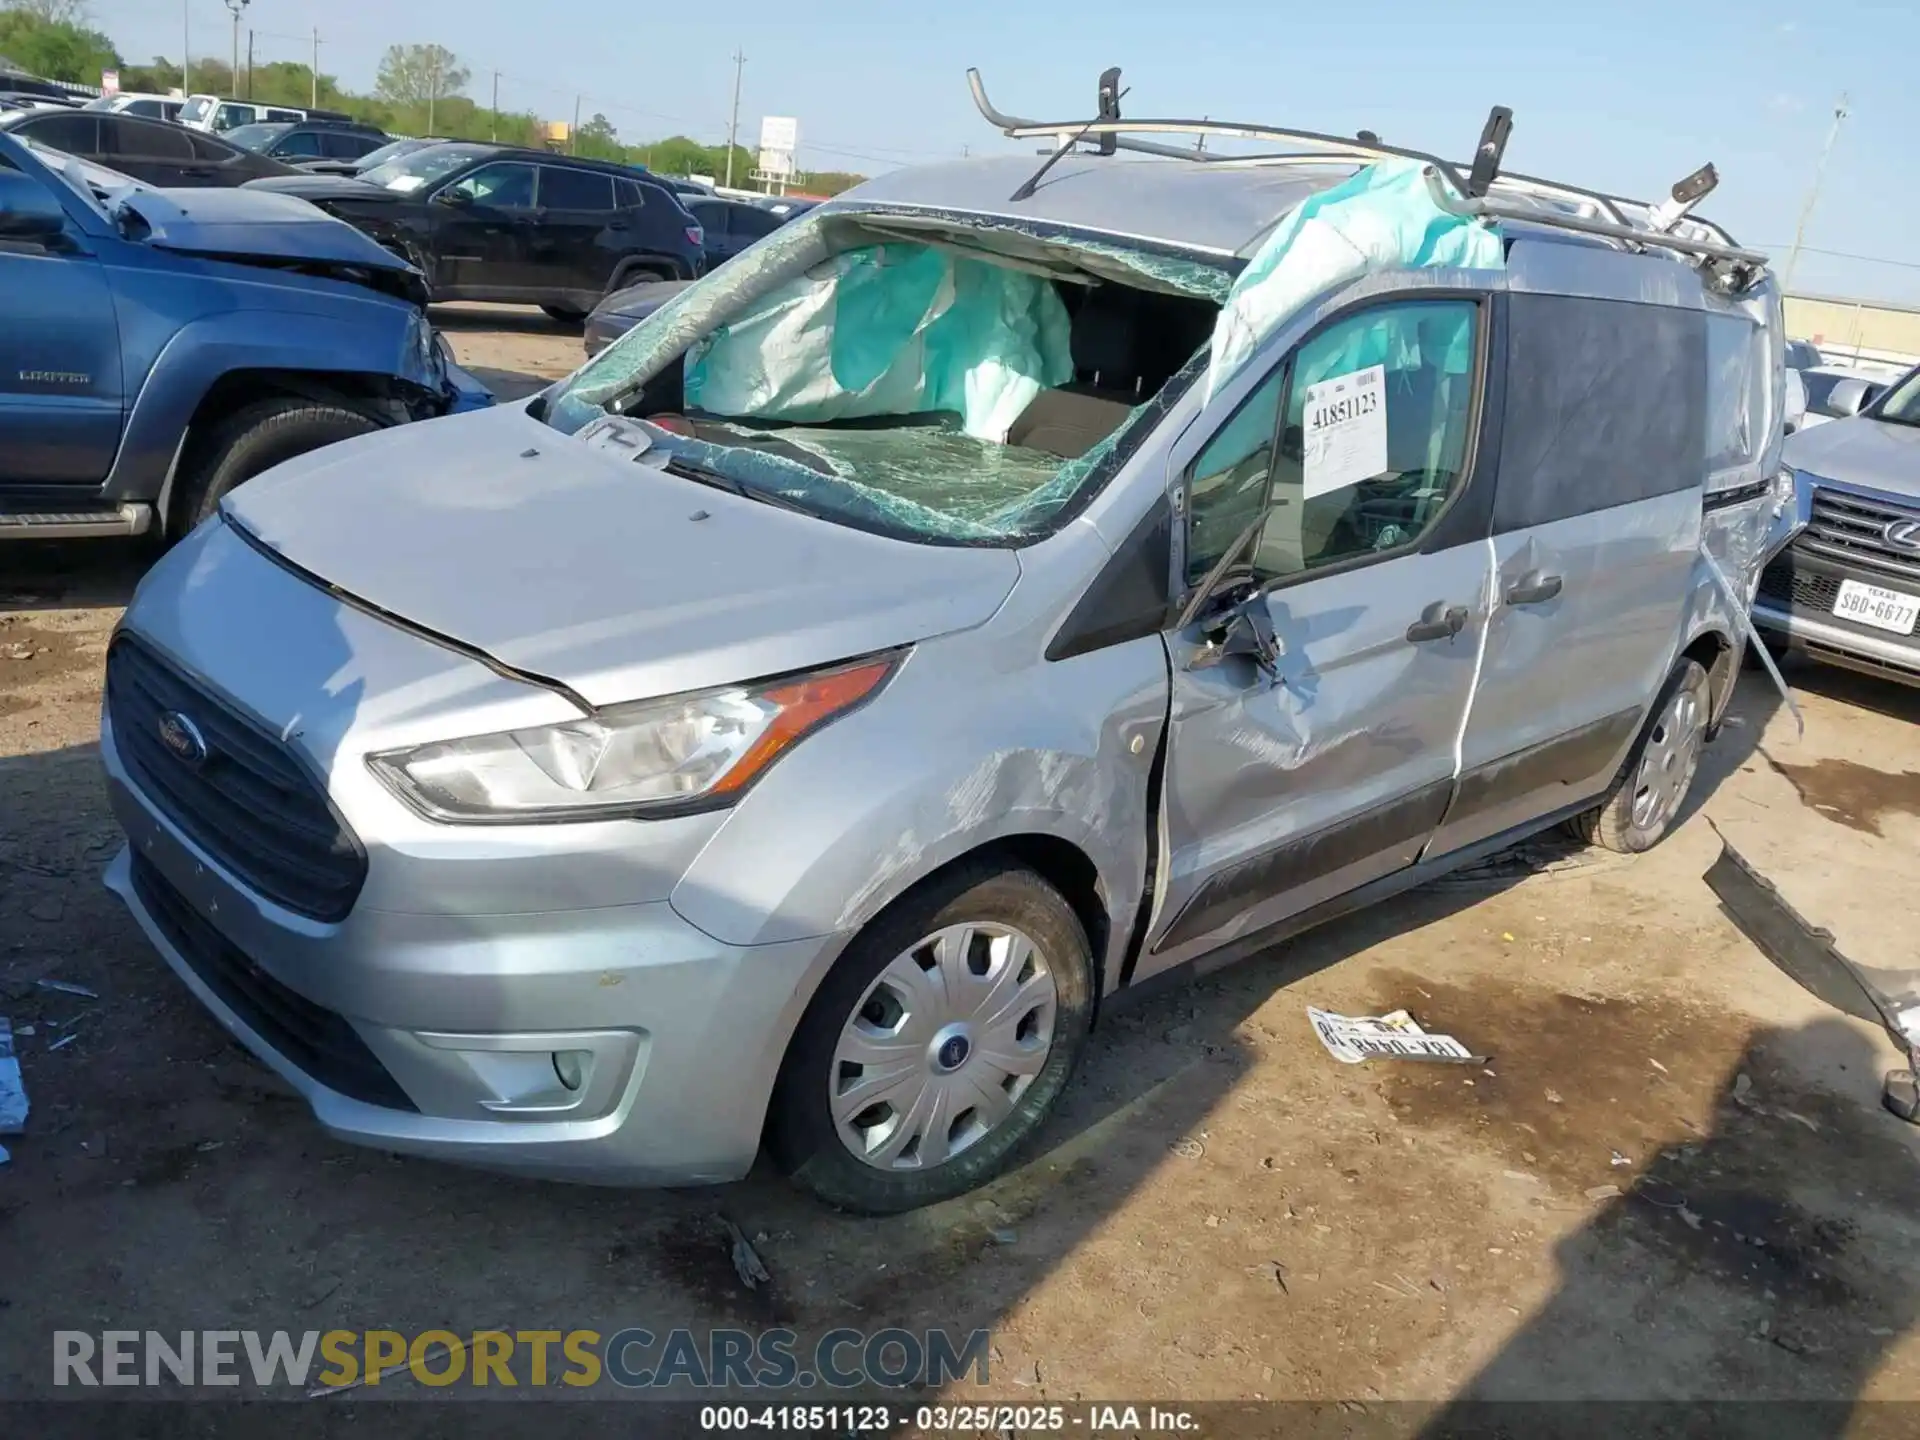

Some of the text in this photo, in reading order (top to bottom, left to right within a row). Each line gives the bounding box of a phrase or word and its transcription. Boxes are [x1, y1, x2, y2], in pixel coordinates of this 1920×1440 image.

[19, 371, 89, 383] LIMITED
[1313, 391, 1377, 429] 41851123
[1868, 587, 1897, 601] TEXAS
